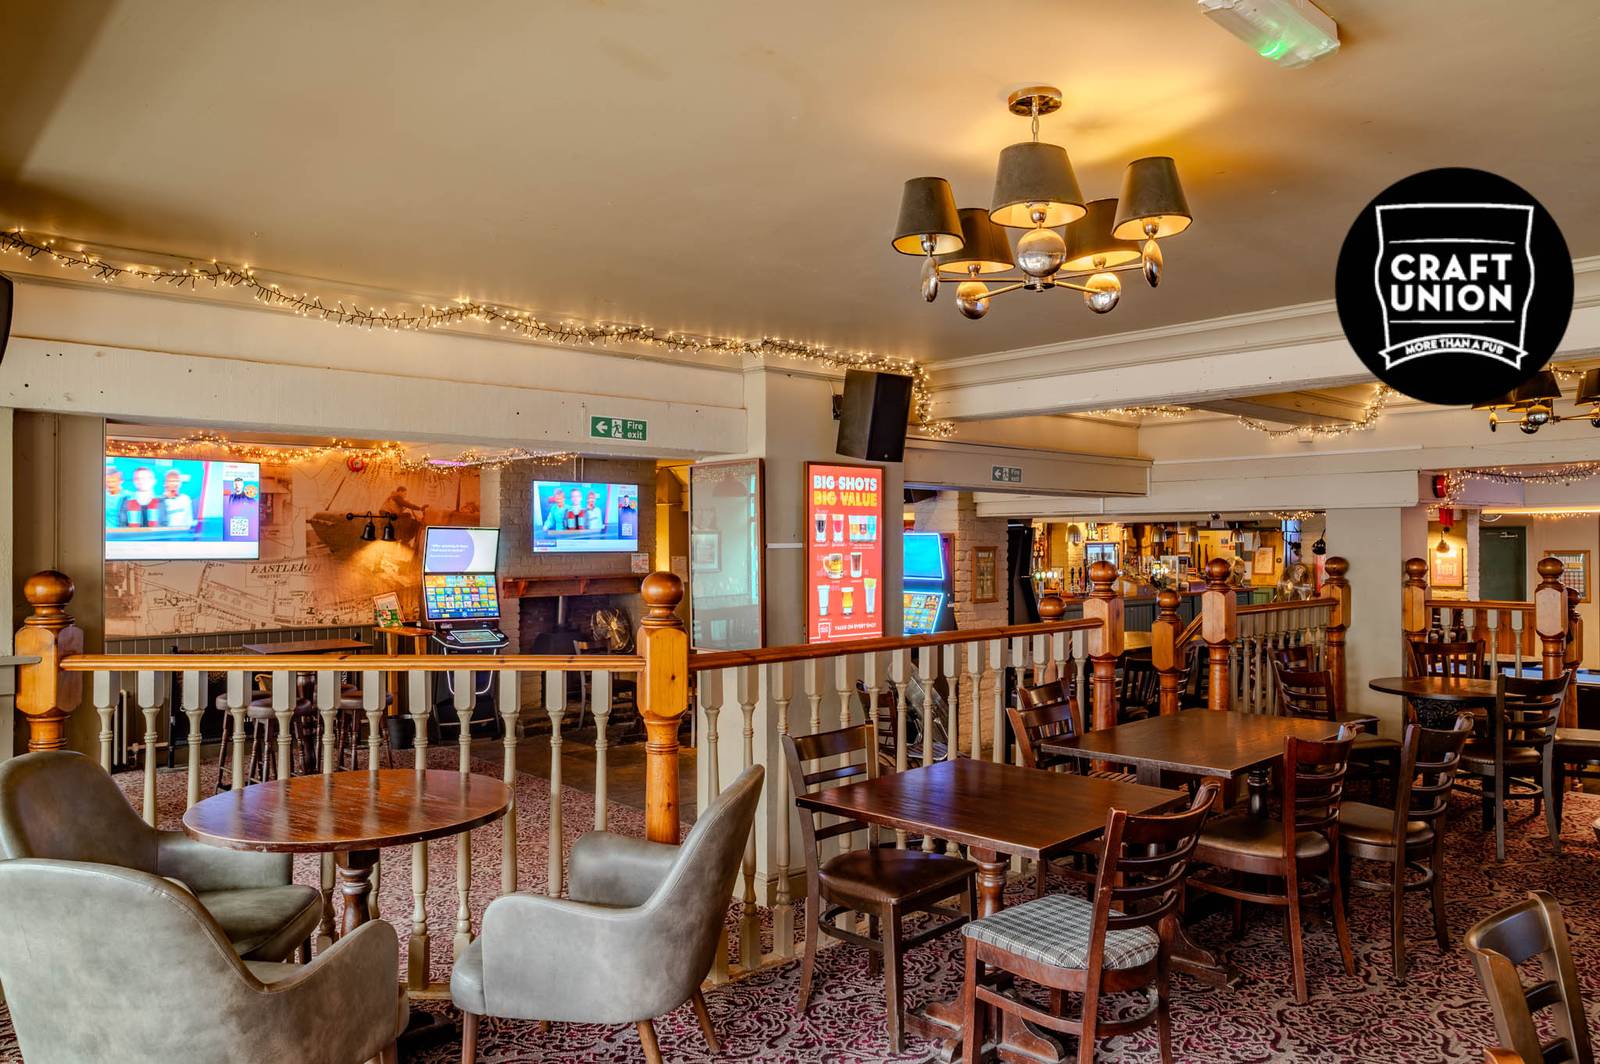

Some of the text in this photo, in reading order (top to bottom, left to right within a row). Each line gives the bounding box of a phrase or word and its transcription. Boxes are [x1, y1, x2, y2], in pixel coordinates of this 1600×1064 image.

[627, 421, 643, 430] Fire
[627, 431, 643, 439] exit
[814, 475, 877, 491] BIG SHOTS
[814, 490, 877, 507] BIG VALUE
